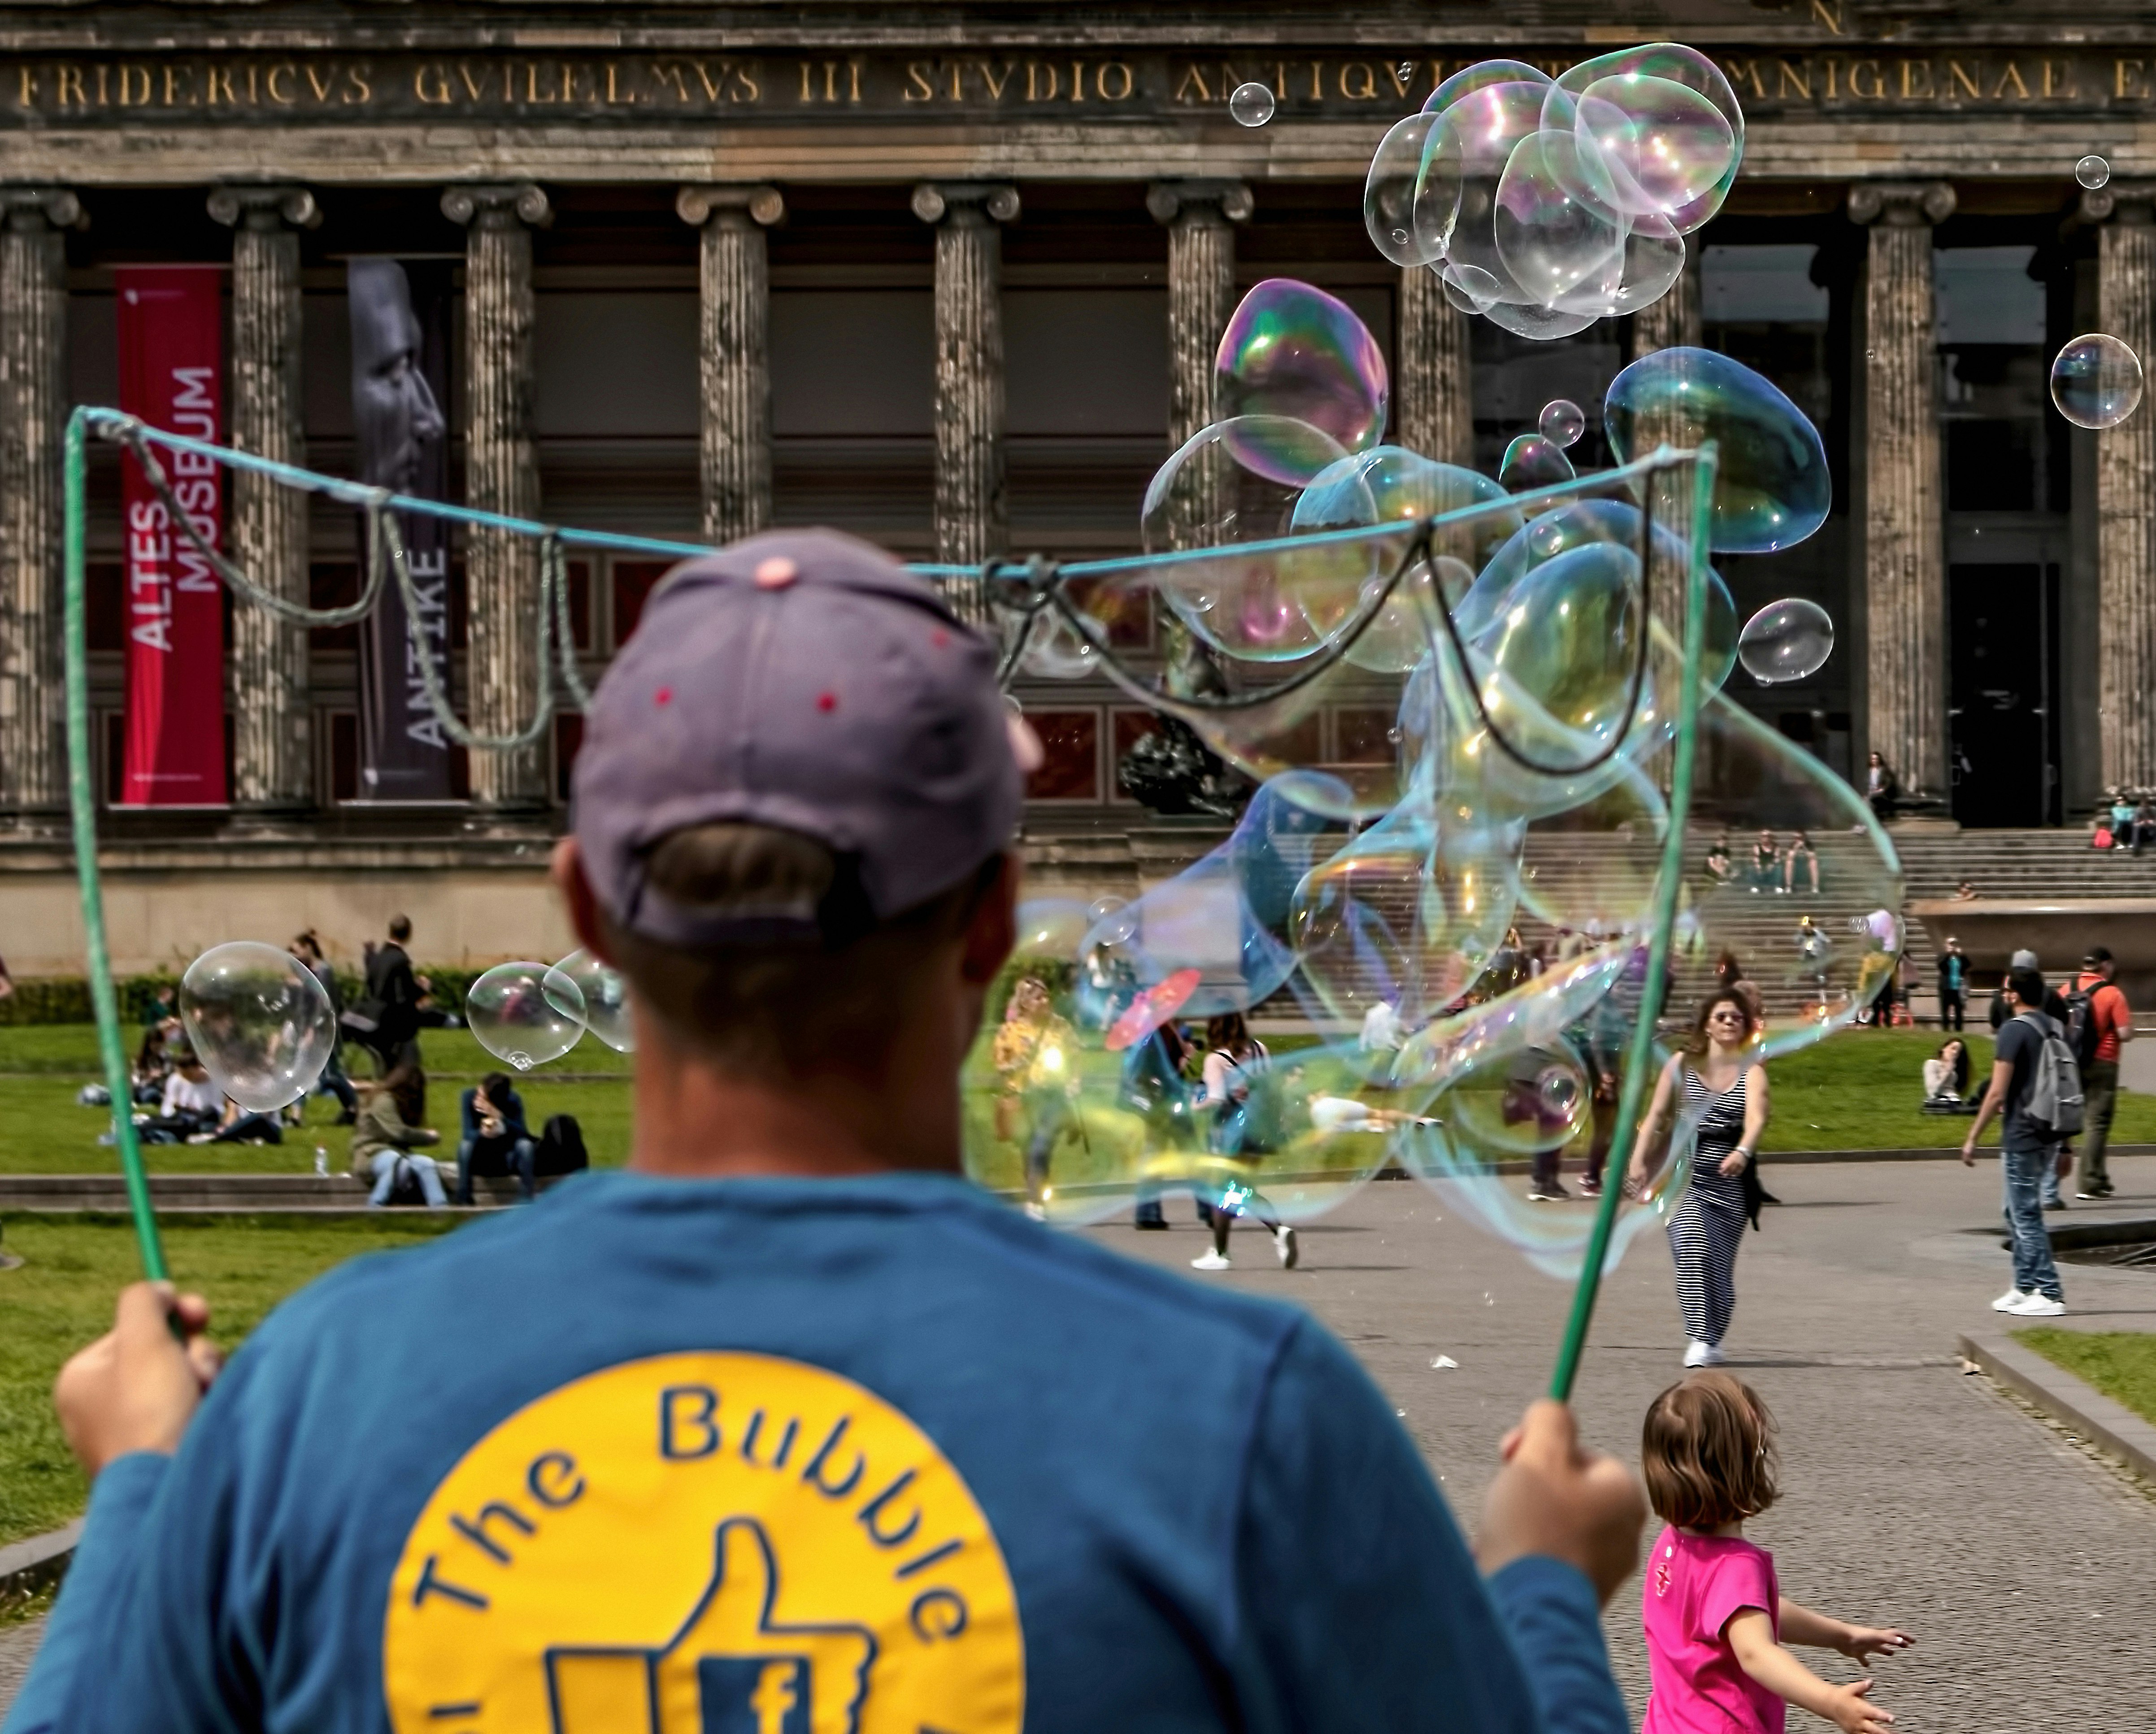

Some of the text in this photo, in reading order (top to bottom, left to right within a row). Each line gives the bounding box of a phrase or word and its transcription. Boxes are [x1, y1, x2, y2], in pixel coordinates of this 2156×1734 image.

[19, 64, 371, 106] FRIDERICVS
[799, 61, 862, 102] III
[904, 61, 1134, 101] STVDIO
[2114, 59, 2156, 99] E
[130, 500, 174, 652] ALTES
[171, 366, 218, 593] MUSEUM
[407, 547, 448, 750] ANTIKE
[413, 1383, 969, 1645] The Bubble
